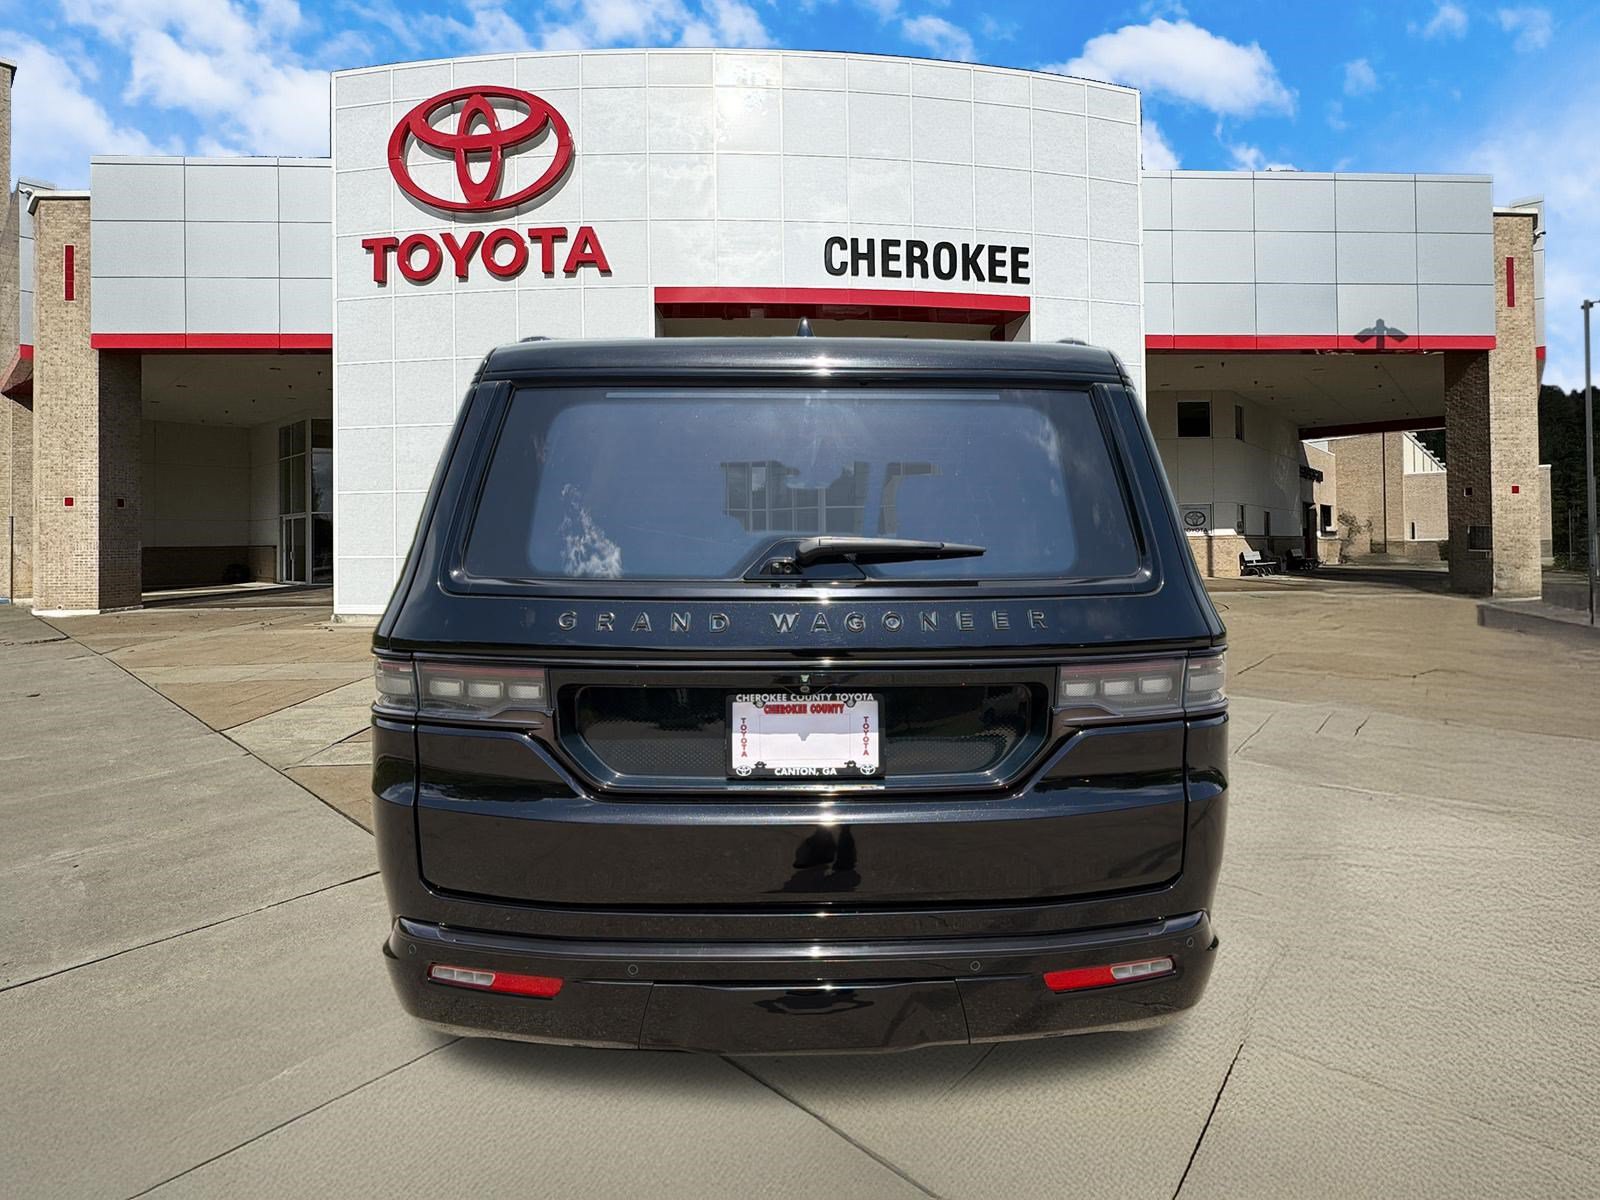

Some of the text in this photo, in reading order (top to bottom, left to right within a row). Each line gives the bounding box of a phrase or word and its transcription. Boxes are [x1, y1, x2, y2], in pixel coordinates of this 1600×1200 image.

[361, 226, 612, 285] TOYOTA
[824, 236, 1031, 285] CHEROKEE
[557, 609, 1049, 633] GRAND WAGONEER
[736, 693, 874, 702] CHEROKEE COUNTY TOYOTA
[763, 703, 844, 714] CHEROKEE COUNTY
[862, 716, 870, 756] TOYOTA
[774, 767, 837, 776] CANTON, GA
